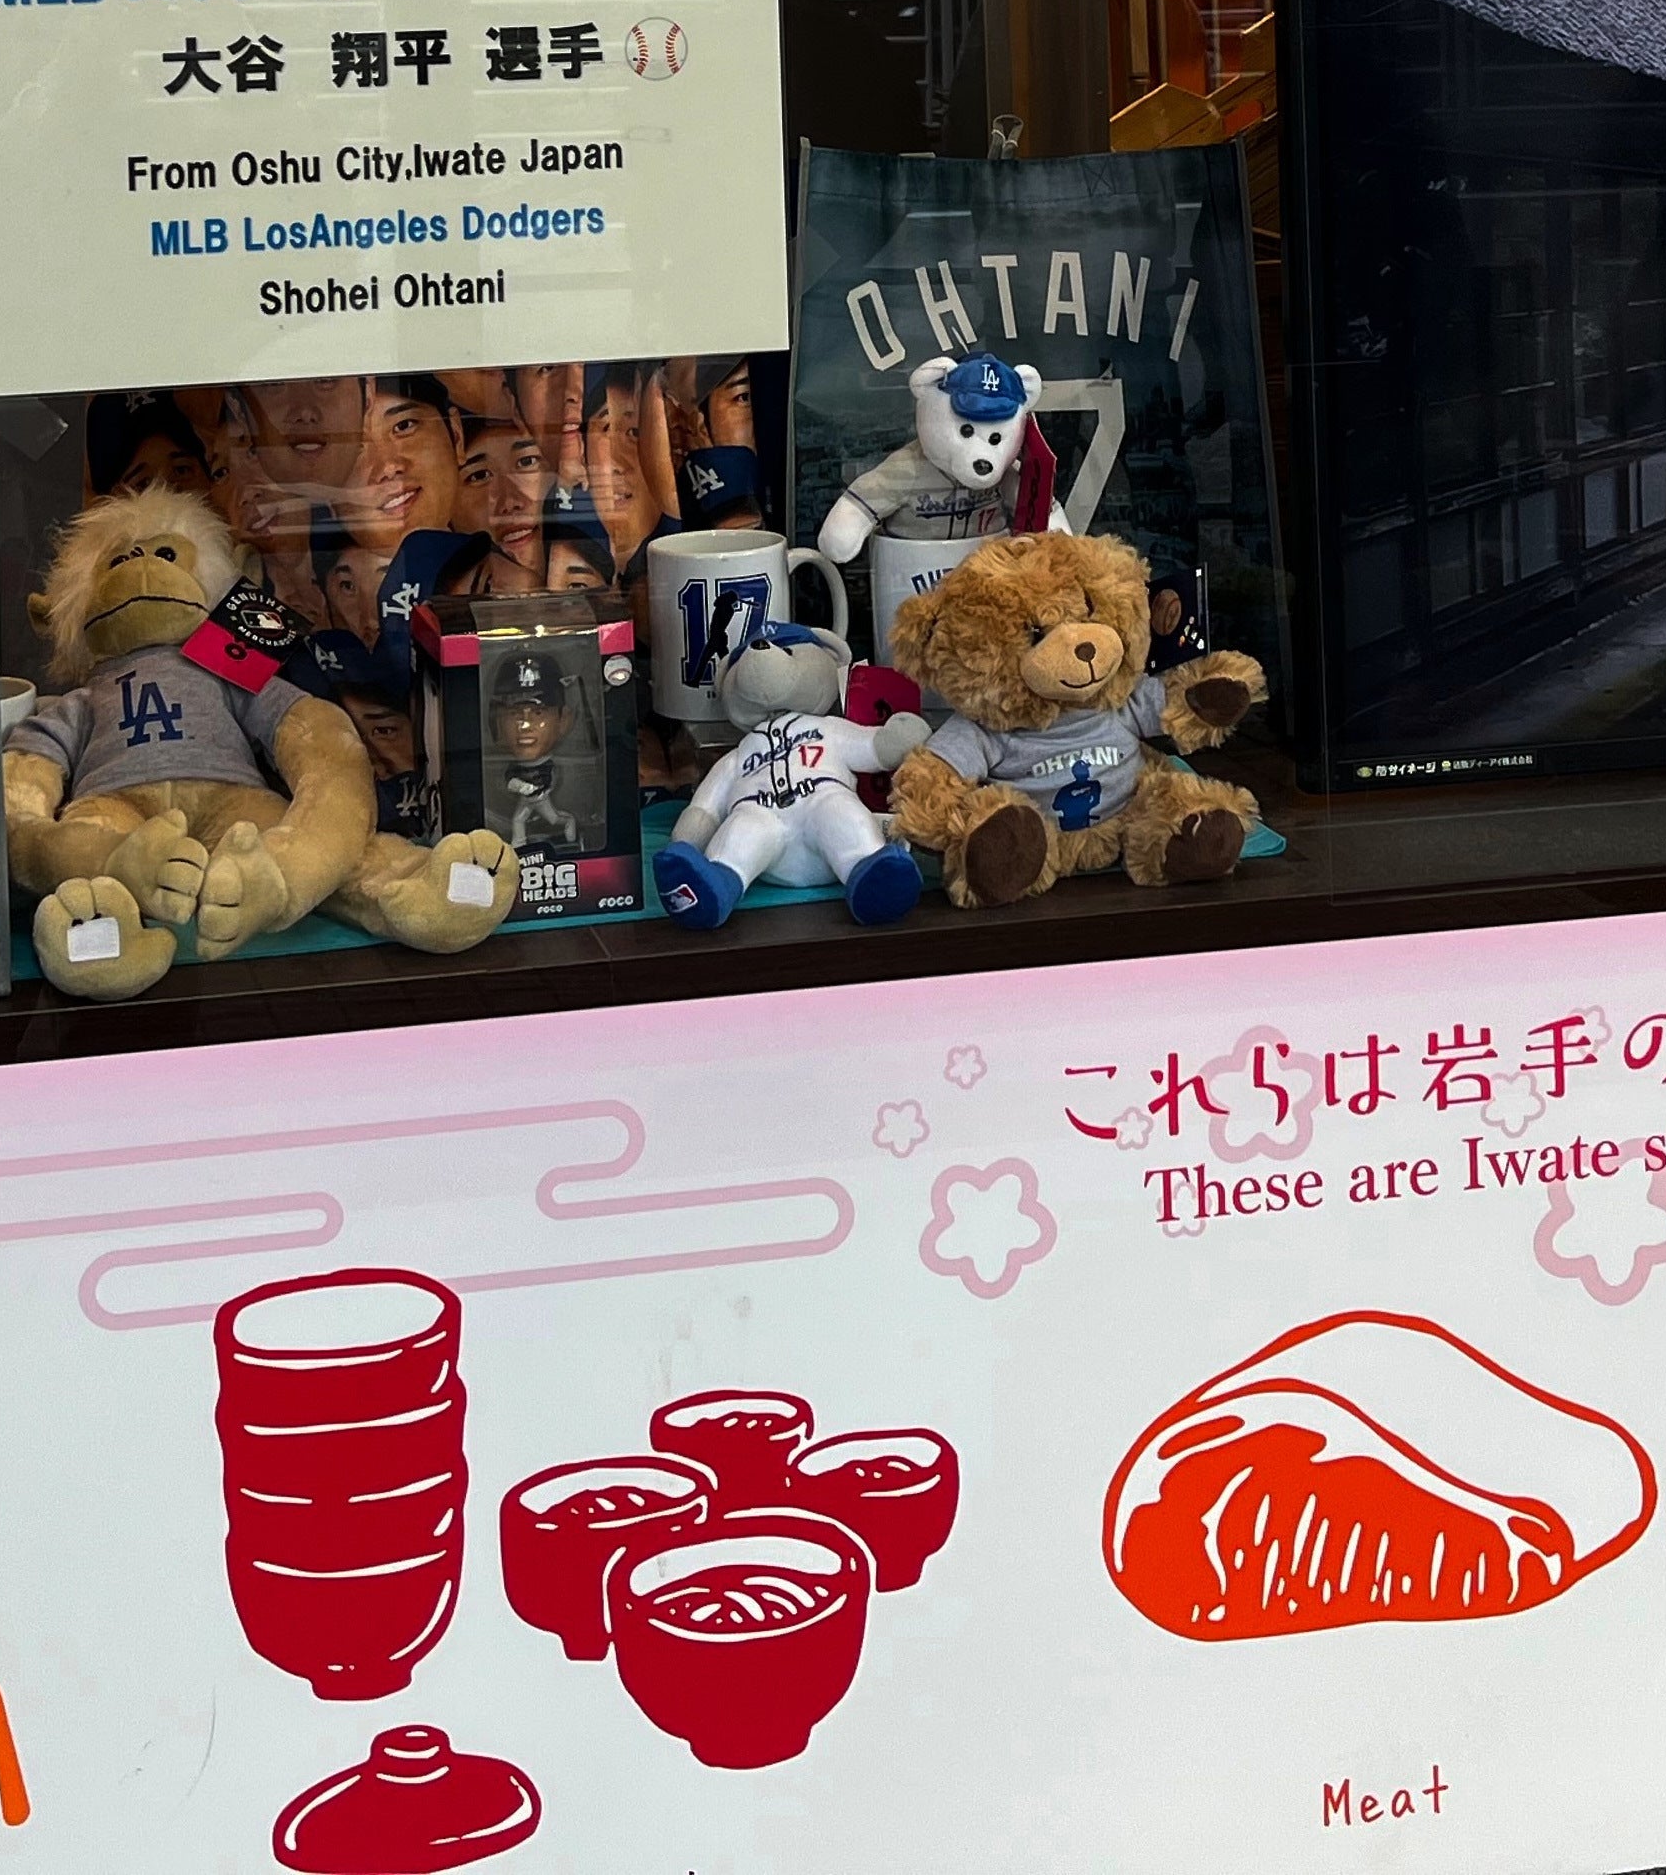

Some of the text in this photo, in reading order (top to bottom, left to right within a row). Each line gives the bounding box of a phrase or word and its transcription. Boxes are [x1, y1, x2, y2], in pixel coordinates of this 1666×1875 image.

[162, 22, 604, 97] 大谷 翔平 選手
[127, 139, 624, 192] From Oshu City,Iwate Japan
[149, 204, 606, 258] MLB LosAngeles Dodgers
[259, 269, 505, 318] Shohei Ohtani
[846, 249, 1200, 372] OHTANI
[977, 507, 997, 534] 17
[226, 592, 287, 613] GENUINE
[115, 670, 183, 747] LA
[798, 745, 824, 768] 17
[1032, 746, 1120, 778] OHTANI
[520, 863, 576, 890] BIG
[522, 886, 577, 902] HEADS
[536, 904, 563, 915] FOCO
[598, 895, 634, 908] FOCO
[1142, 1162, 1325, 1224] These
[1348, 1153, 1439, 1199] are
[1460, 1133, 1621, 1193] Iwate
[1322, 1764, 1449, 1827] Meat
